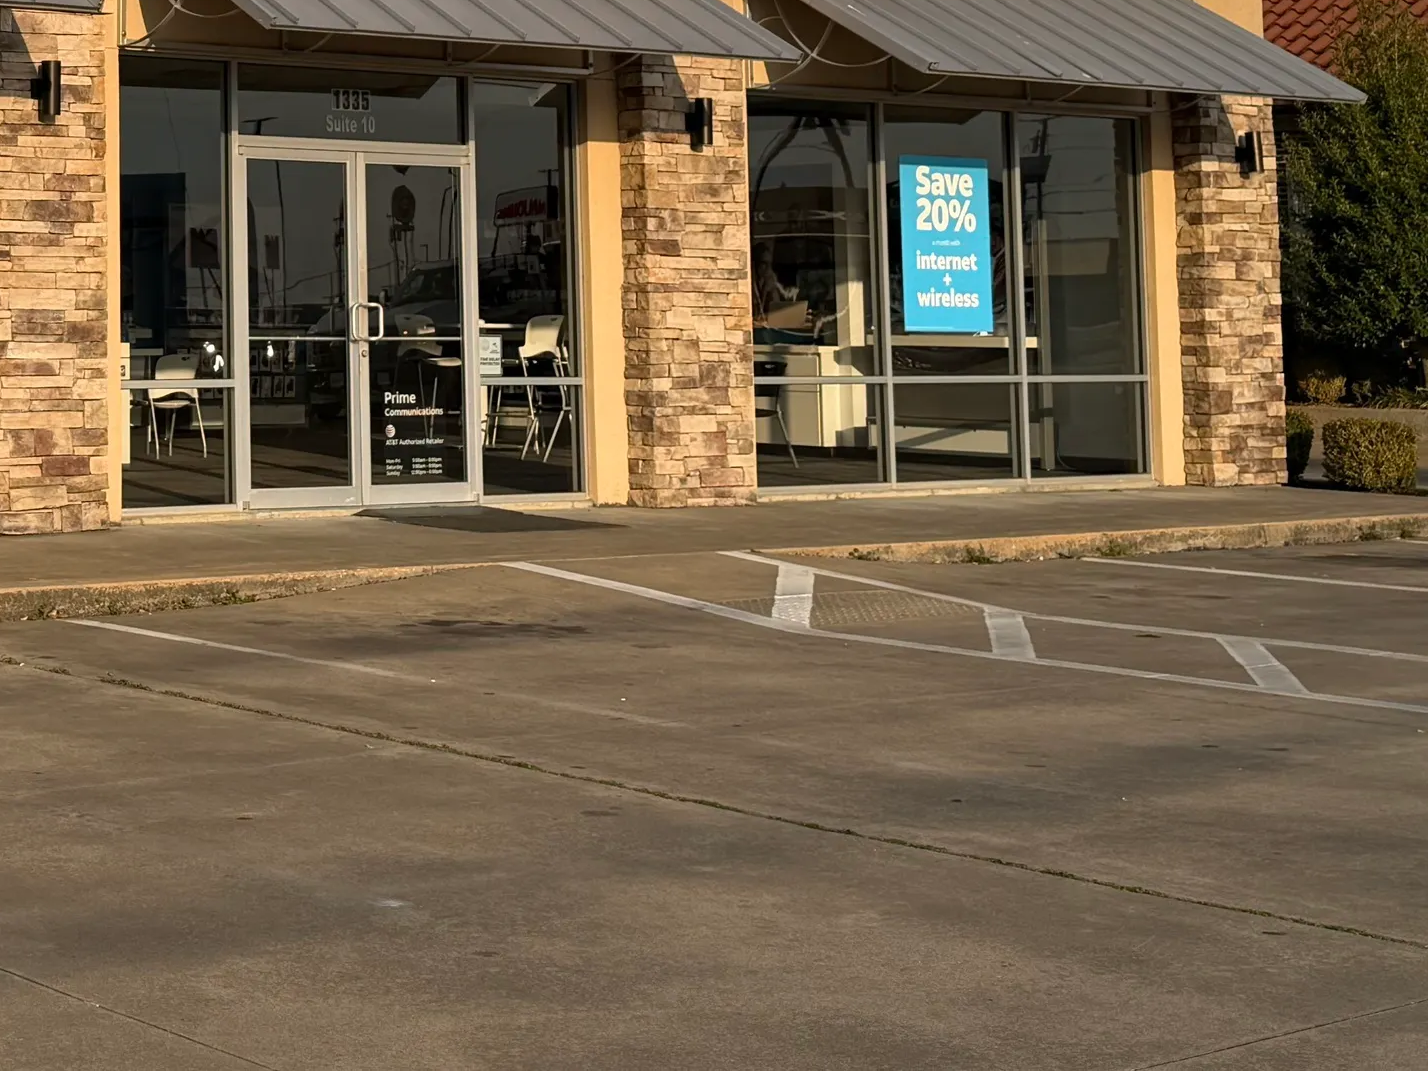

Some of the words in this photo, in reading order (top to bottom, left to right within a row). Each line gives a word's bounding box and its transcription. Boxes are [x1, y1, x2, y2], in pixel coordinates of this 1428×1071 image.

[332, 89, 370, 111] 1335
[325, 115, 358, 133] Suite
[362, 116, 375, 133] 10
[915, 165, 974, 197] Save
[916, 197, 977, 233] 20%
[916, 250, 978, 271] internet
[943, 273, 952, 286] +
[917, 287, 980, 308] wireless
[384, 391, 417, 404] Prime
[384, 406, 444, 417] Communications
